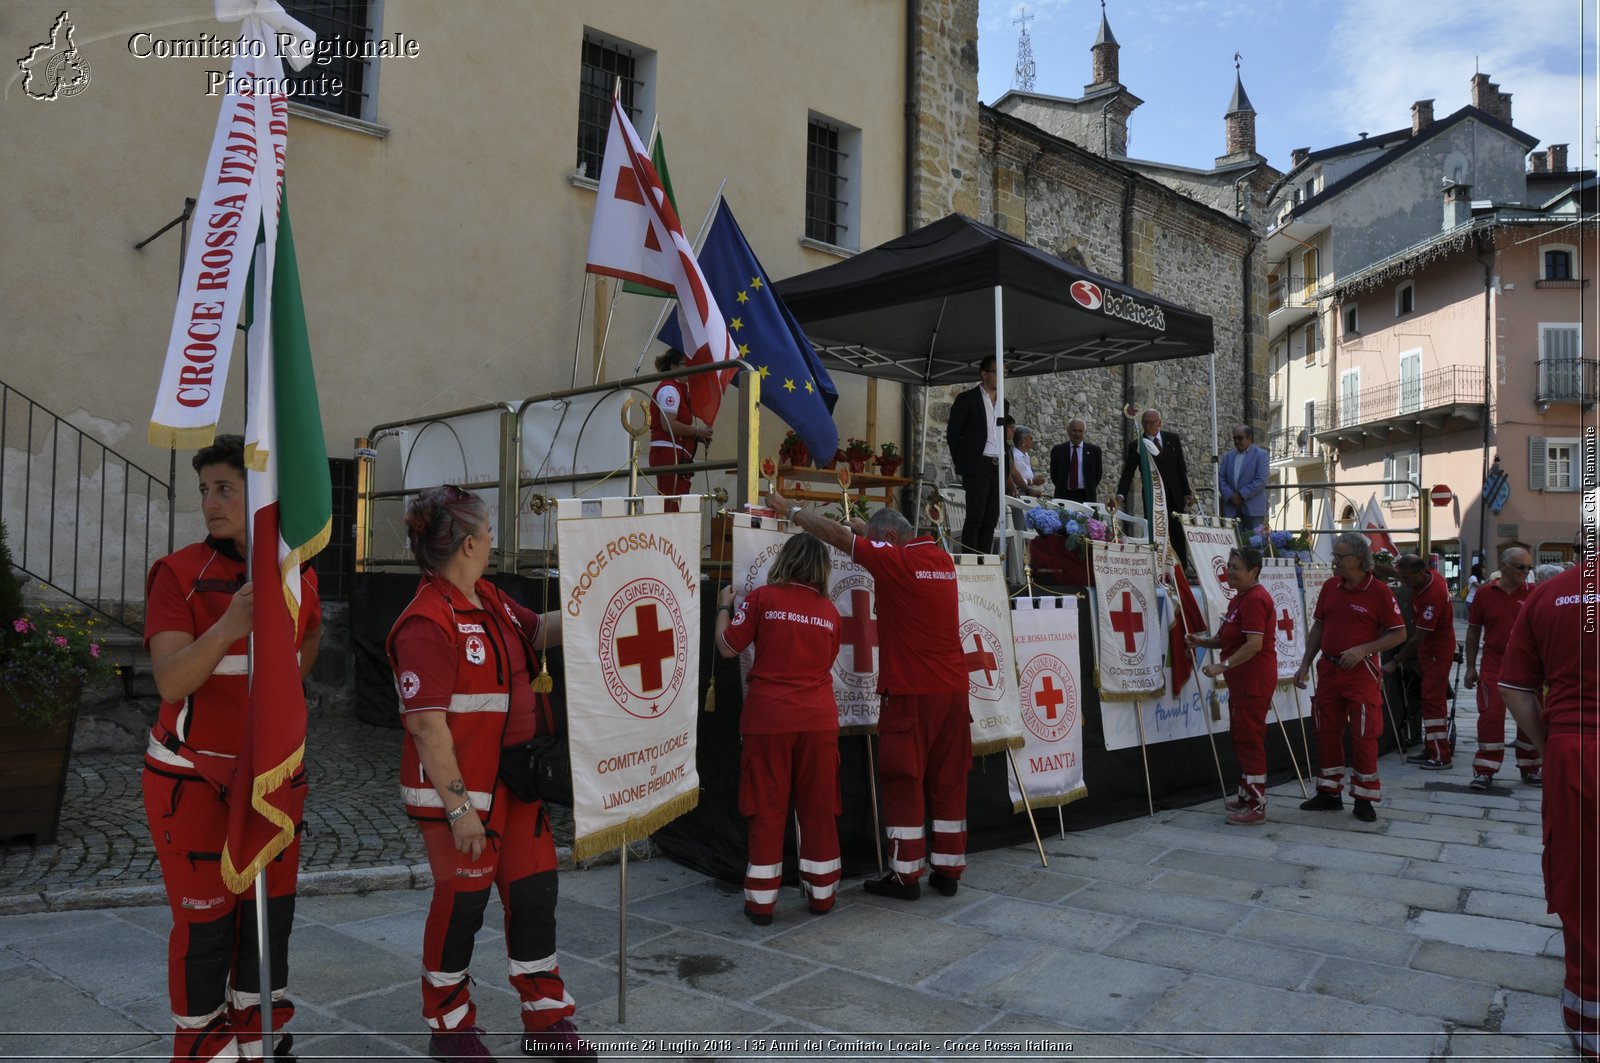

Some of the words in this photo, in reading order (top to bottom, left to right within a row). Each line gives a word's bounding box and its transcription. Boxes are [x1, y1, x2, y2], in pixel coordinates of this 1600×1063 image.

[195, 193, 247, 293] ROSSA
[175, 300, 225, 408] CROCE
[567, 551, 608, 617] CROCE
[606, 532, 657, 560] ROSSA
[658, 536, 697, 598] ITALIANA
[624, 582, 668, 600] GINEVRA
[613, 597, 626, 614] DI
[765, 610, 787, 620] CROCE
[788, 612, 809, 624] ROSSA
[1555, 594, 1580, 606] CROCE
[601, 606, 629, 704] CONVENZIONE
[674, 605, 686, 664] AGOSTO
[671, 664, 684, 692] 1864
[597, 745, 660, 775] COMITATO
[659, 732, 689, 757] LOCALE
[1029, 752, 1076, 774] MANTA
[602, 783, 647, 810] LIMONE
[647, 764, 686, 796] PIEMONTE
